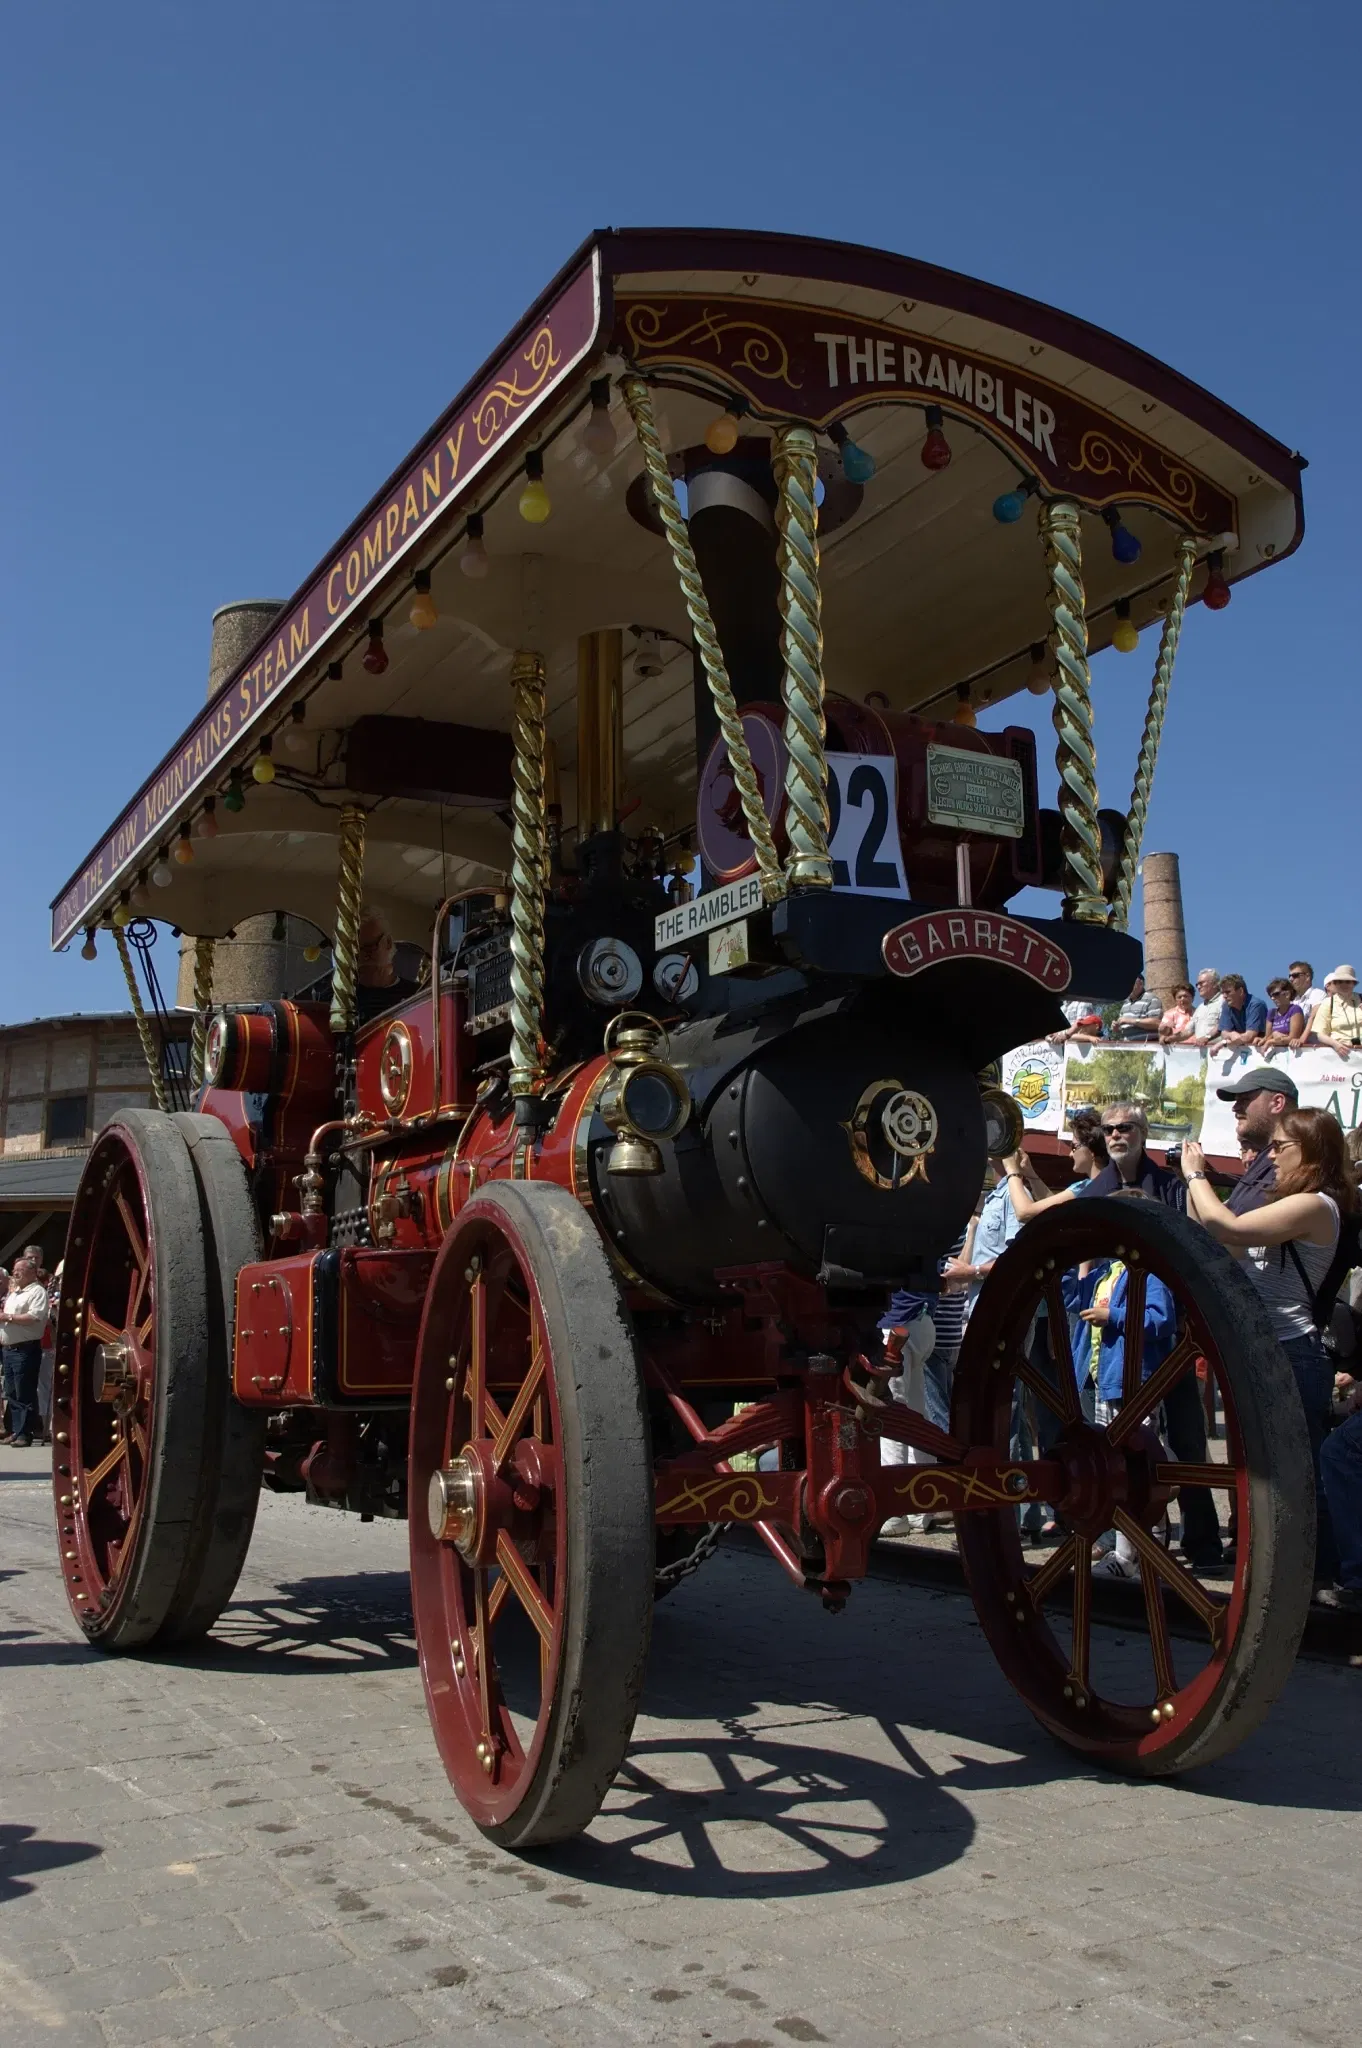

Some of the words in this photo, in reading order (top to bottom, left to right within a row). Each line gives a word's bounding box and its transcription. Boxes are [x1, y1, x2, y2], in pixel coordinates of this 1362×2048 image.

[814, 333, 897, 388] THE
[903, 345, 1058, 468] RAMBLER
[83, 857, 104, 904] THE
[110, 813, 139, 871] LOW
[144, 700, 232, 833] MOUNTAINS
[239, 606, 310, 722] STEAM
[326, 422, 465, 616] COMPANY
[658, 911, 685, 943] THE
[689, 881, 759, 931] RAMBLER
[898, 917, 1060, 978] GARRETT
[1331, 1074, 1345, 1083] hier
